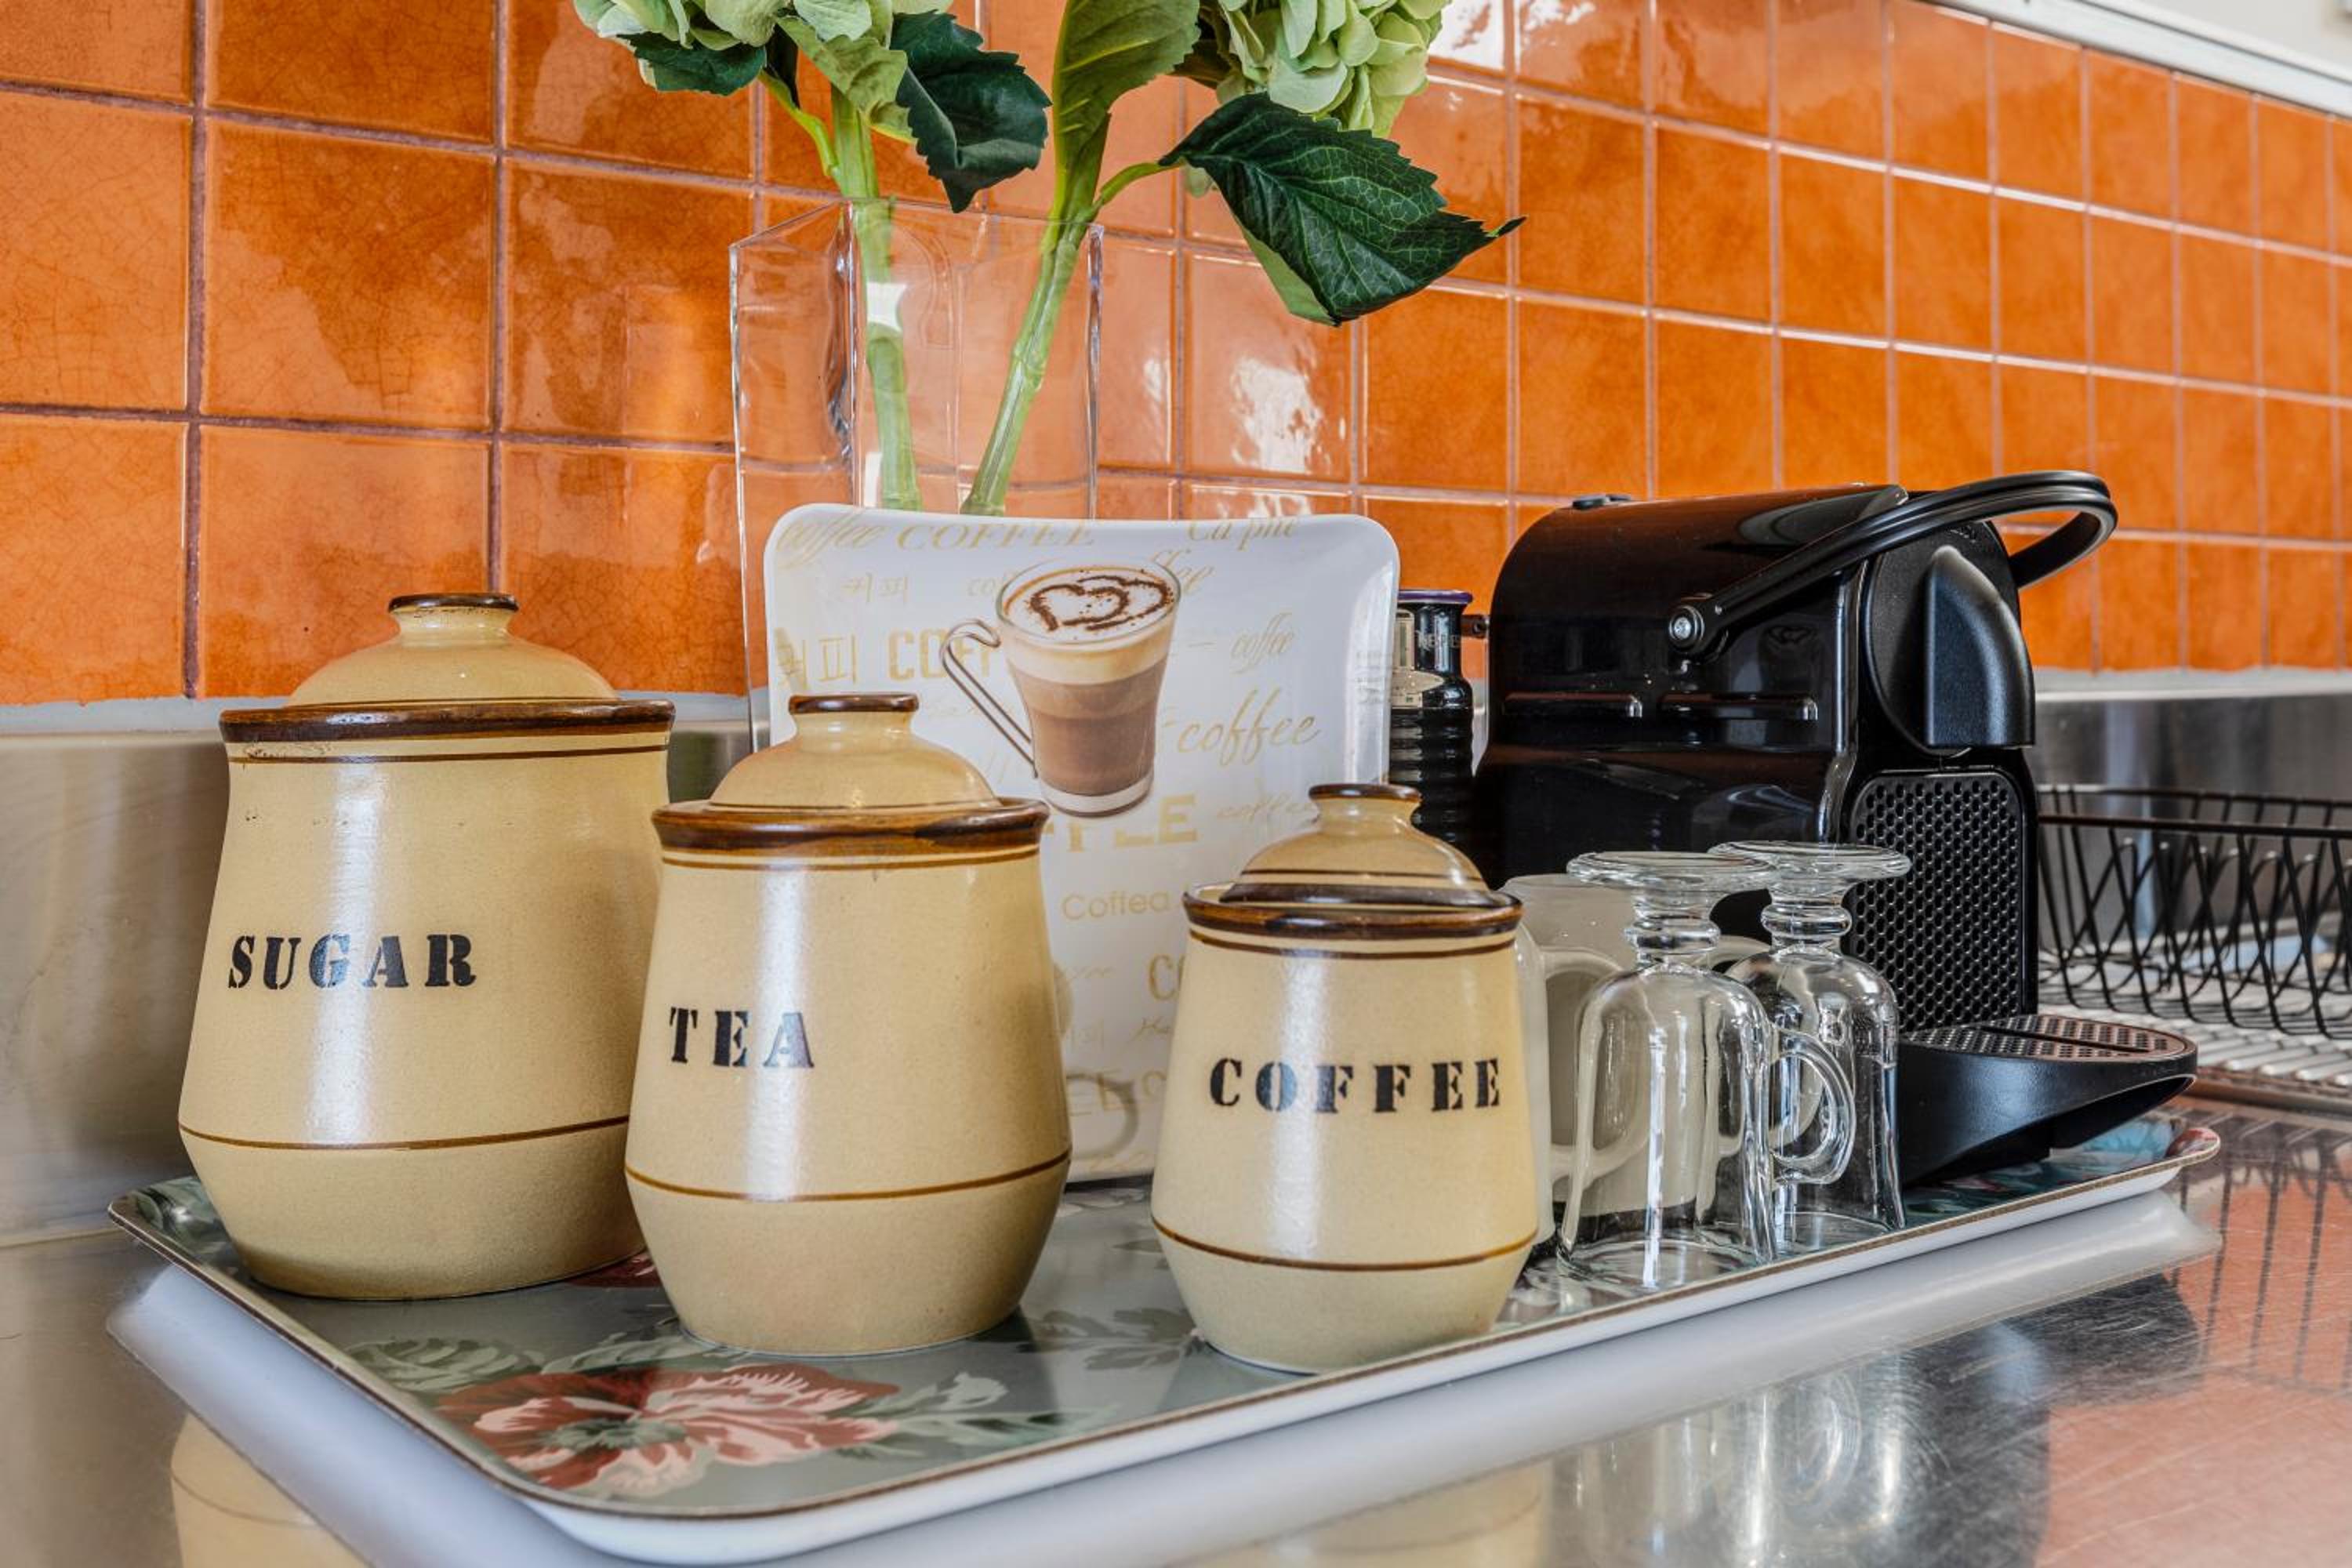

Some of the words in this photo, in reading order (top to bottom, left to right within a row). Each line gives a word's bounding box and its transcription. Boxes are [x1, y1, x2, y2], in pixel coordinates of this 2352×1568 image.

[1178, 685, 1322, 766] coffee
[228, 934, 477, 989] SUGAR
[670, 1007, 815, 1068] TEA
[1210, 1058, 1500, 1113] COFFEE
